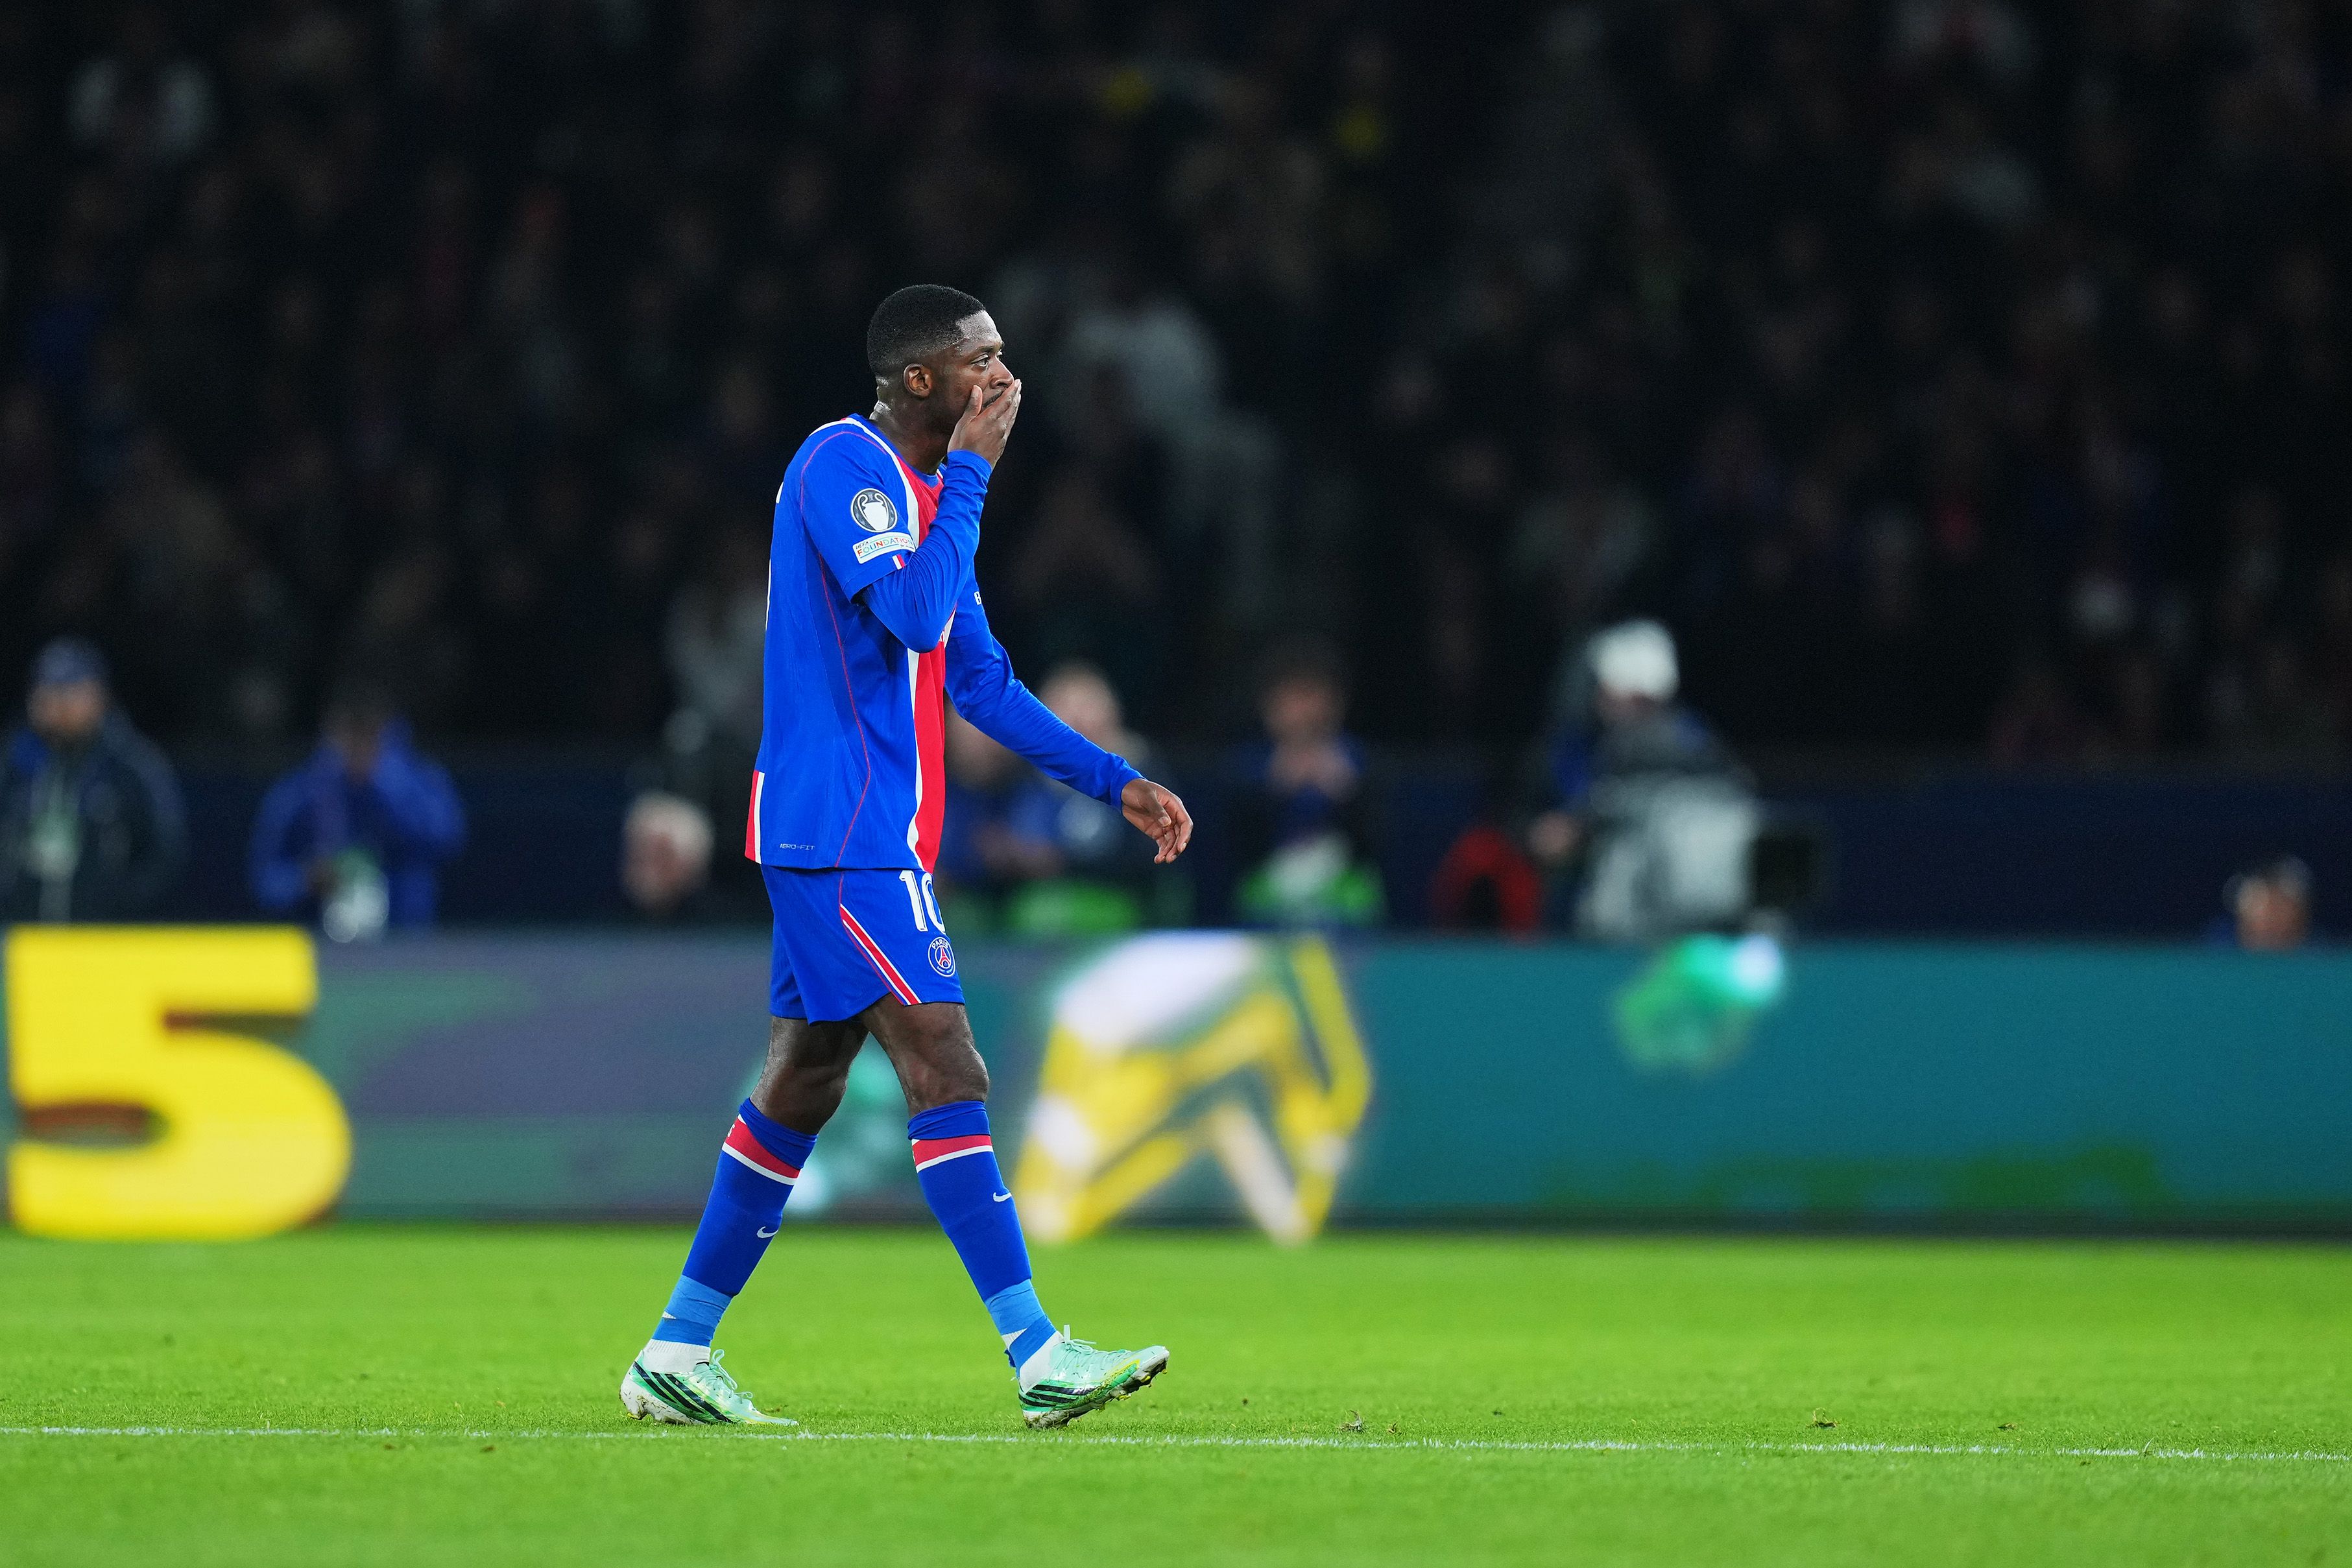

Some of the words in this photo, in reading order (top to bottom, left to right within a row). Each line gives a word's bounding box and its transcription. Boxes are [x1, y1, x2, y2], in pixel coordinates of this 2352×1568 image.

[857, 537, 913, 556] FOUNDATION
[899, 870, 946, 932] 10
[931, 939, 949, 950] PARIS
[5, 923, 354, 1242] 5
